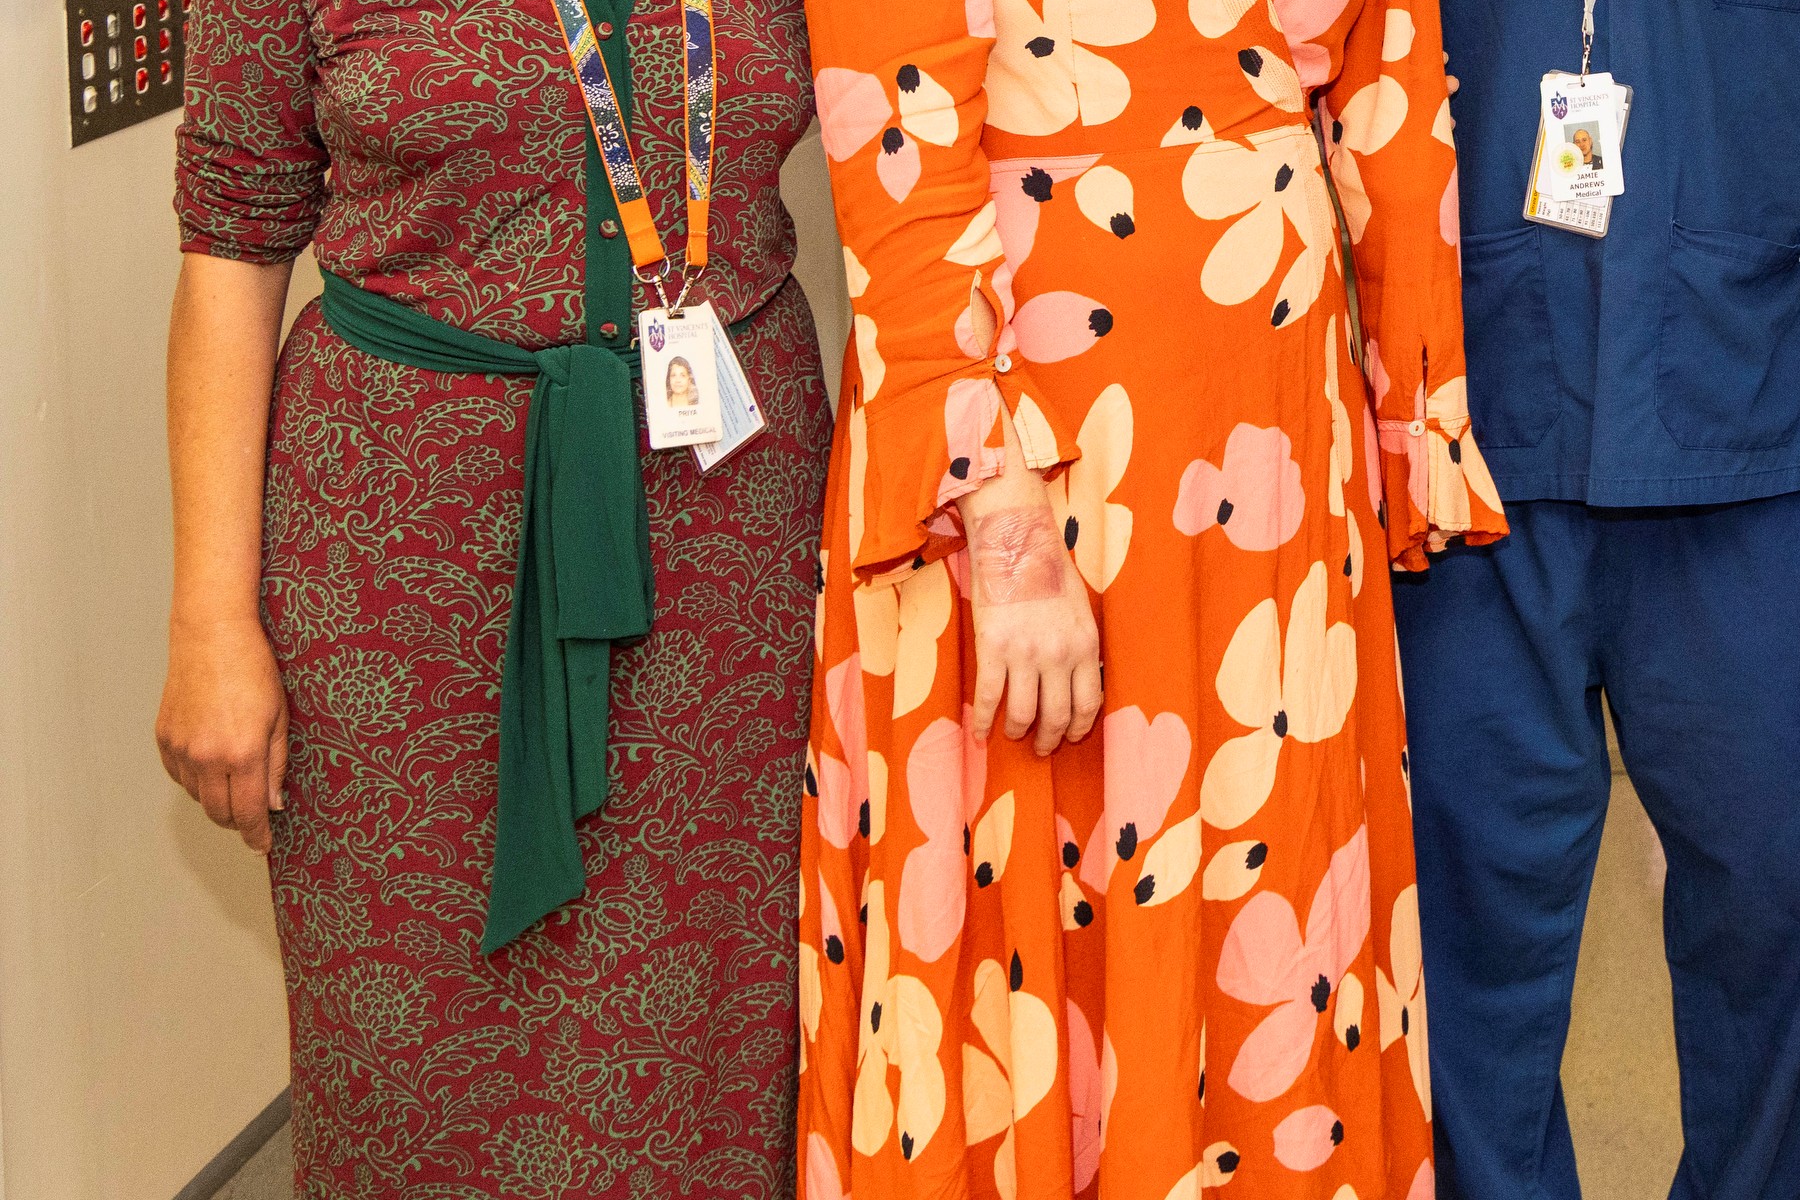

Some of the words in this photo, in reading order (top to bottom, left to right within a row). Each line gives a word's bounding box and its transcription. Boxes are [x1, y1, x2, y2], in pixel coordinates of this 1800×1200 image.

[1577, 171, 1599, 180] JAMIE
[1569, 181, 1605, 190] ANDREWS
[1575, 190, 1602, 198] Medical
[662, 430, 689, 439] VISITING
[690, 427, 717, 437] MEDICAL
